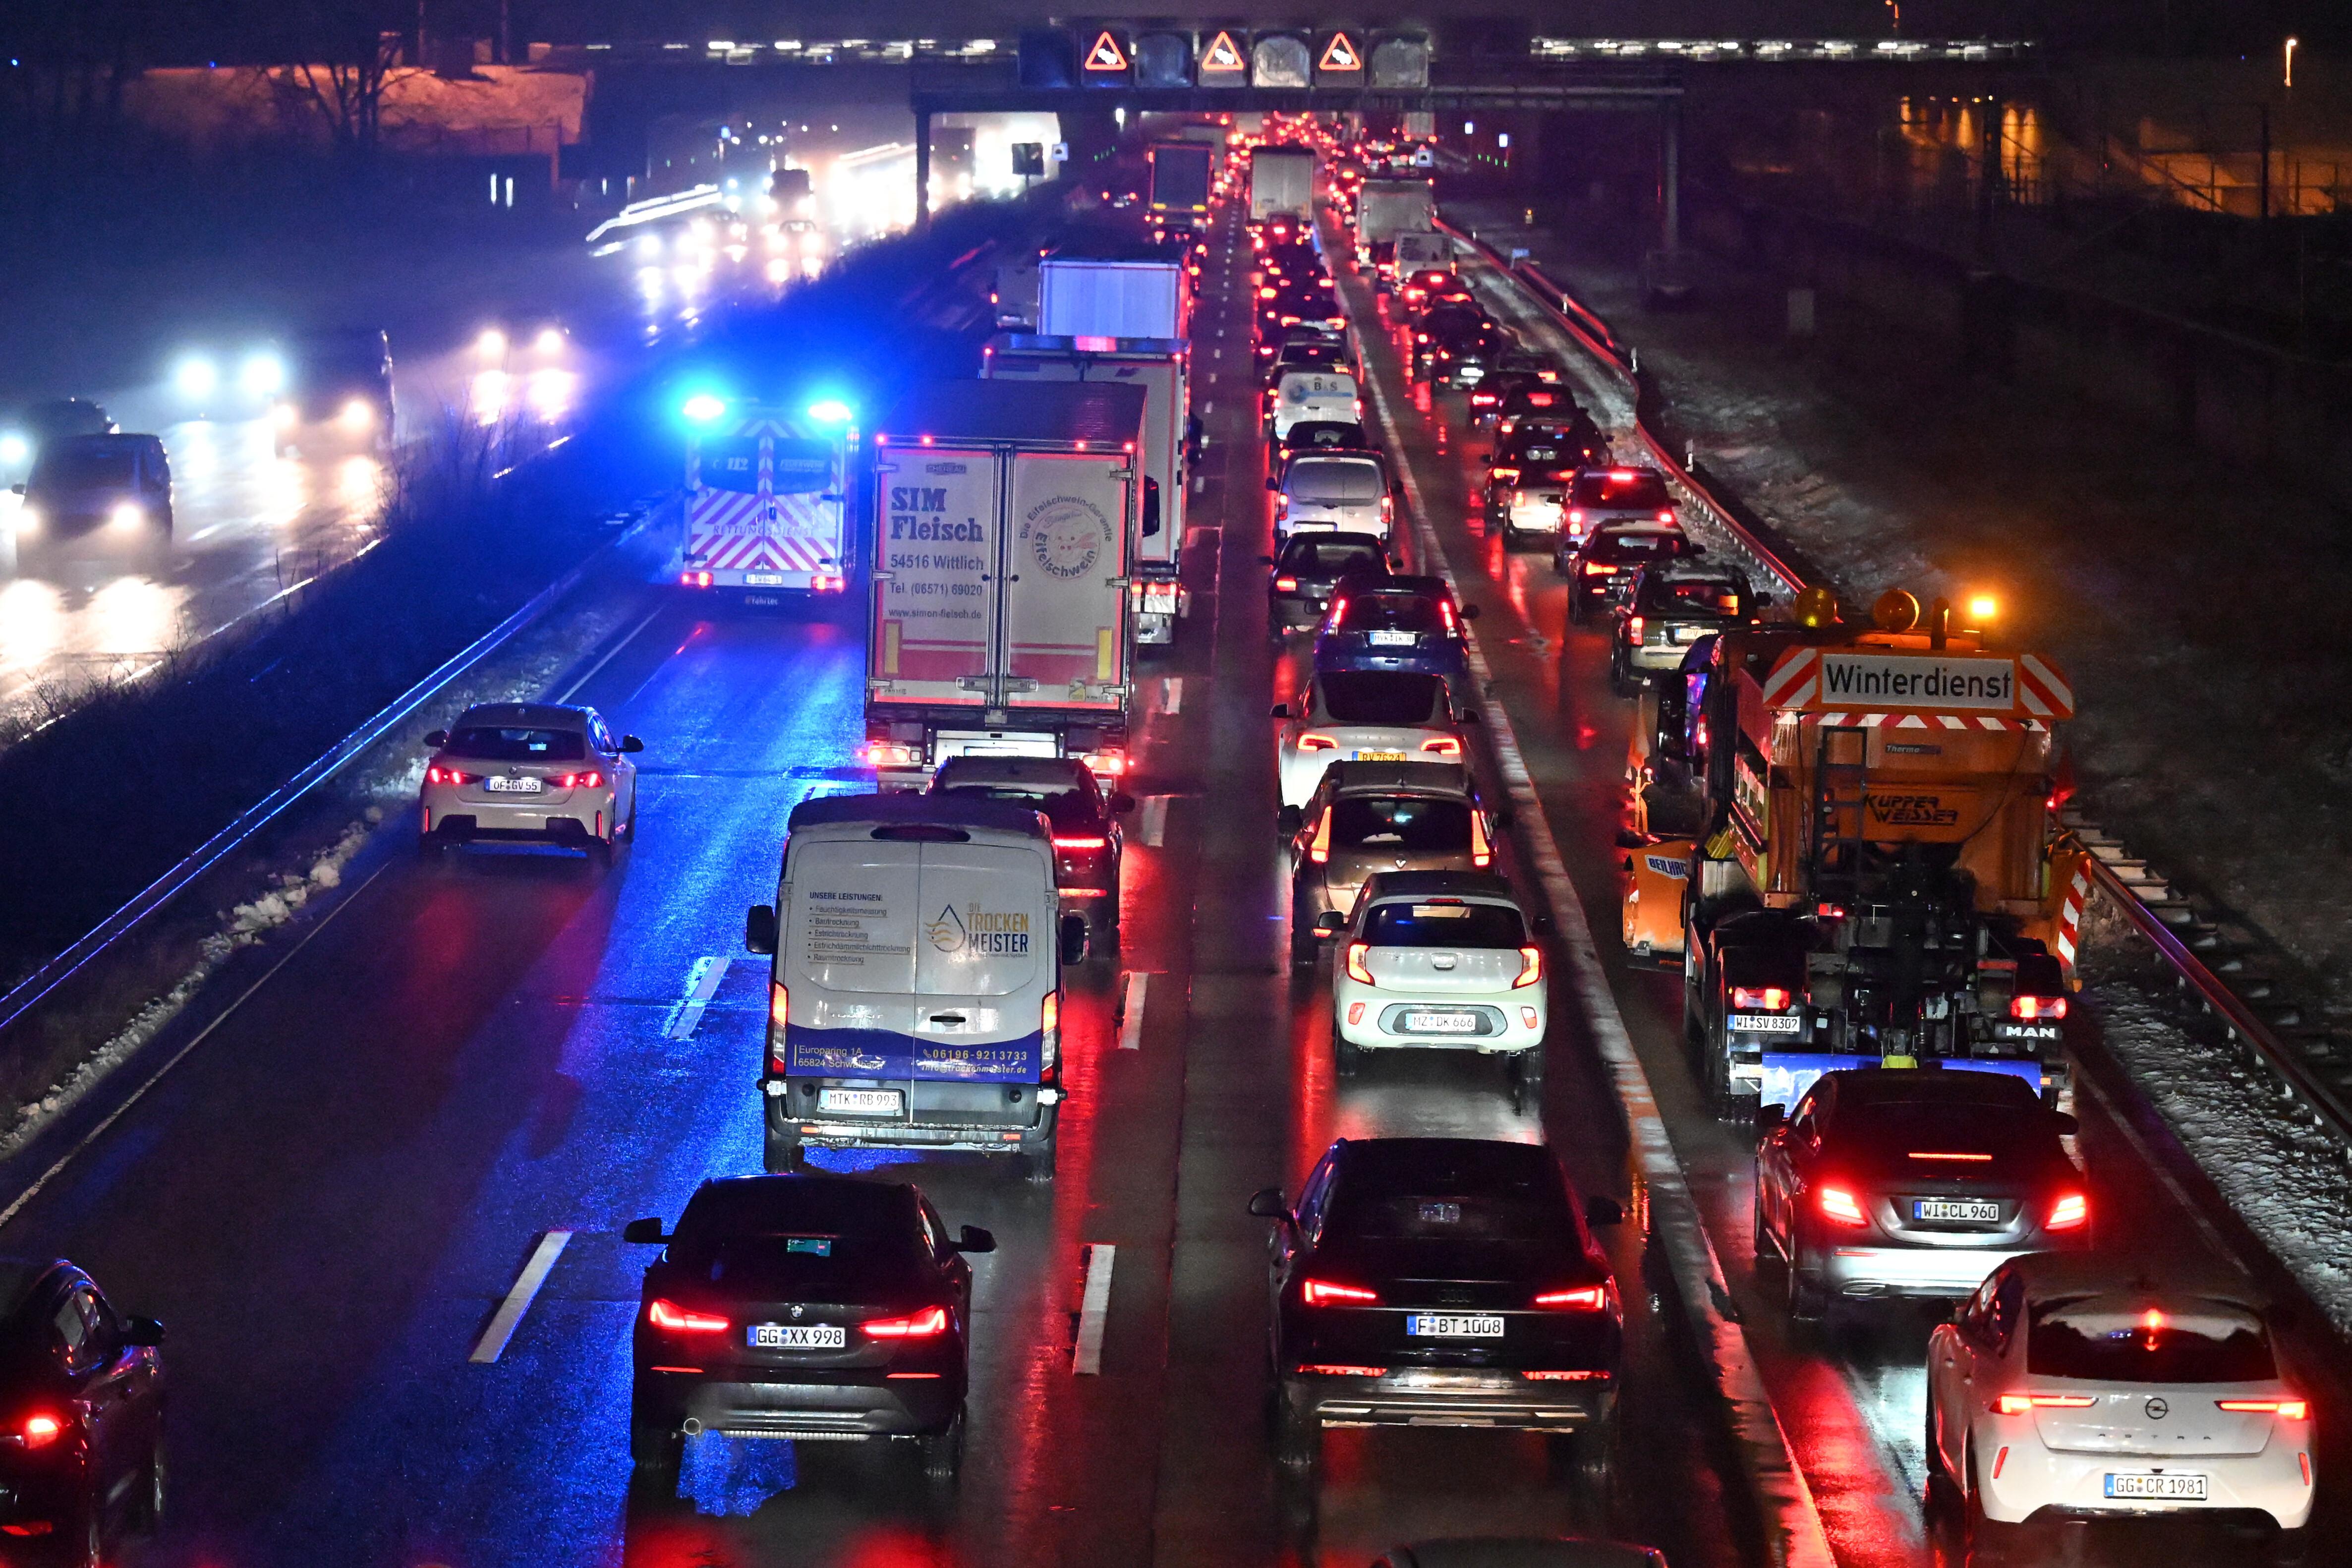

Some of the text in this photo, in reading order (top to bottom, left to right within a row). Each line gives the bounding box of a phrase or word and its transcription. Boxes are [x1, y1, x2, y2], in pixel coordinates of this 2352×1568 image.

[891, 487, 947, 512] SIM
[1027, 495, 1113, 542] Eifelschwein-Garantie
[891, 516, 983, 542] Fleisch
[1020, 523, 1031, 539] Die
[1035, 532, 1096, 577] Eifelschwein
[891, 554, 984, 570] 54516 Wittlich
[911, 583, 948, 597] (06571)
[952, 584, 982, 595] 69020
[889, 608, 982, 619] www.simon-fleisch.de
[1826, 663, 2011, 698] Winterdienst
[494, 781, 537, 790] OF GV 55
[839, 893, 883, 902] LEISTUNGEN:
[969, 903, 980, 912] DIE
[814, 918, 860, 928] Bautrocknung
[967, 912, 1029, 932] TROCKEN
[969, 933, 1028, 952] MEISTER
[813, 954, 864, 963] Raumtrocknung
[1414, 1016, 1473, 1027] MZ DK 666
[1736, 1017, 1748, 1028] WI
[1756, 1018, 1769, 1028] SV
[2006, 1026, 2055, 1038] MAN
[799, 1045, 847, 1056] Europaring
[798, 1058, 825, 1067] 65824
[829, 1093, 897, 1106] MTK RB 993
[1924, 1204, 1940, 1217] WI
[1950, 1204, 1967, 1218] CL
[1971, 1205, 1996, 1219] 960
[1418, 1318, 1501, 1334] F BT 1008
[757, 1329, 778, 1343] GG
[789, 1329, 809, 1344] XX
[813, 1330, 842, 1345] 998
[2116, 1477, 2134, 1493] GG
[2146, 1478, 2164, 1494] CR
[2169, 1478, 2204, 1494] 1981
